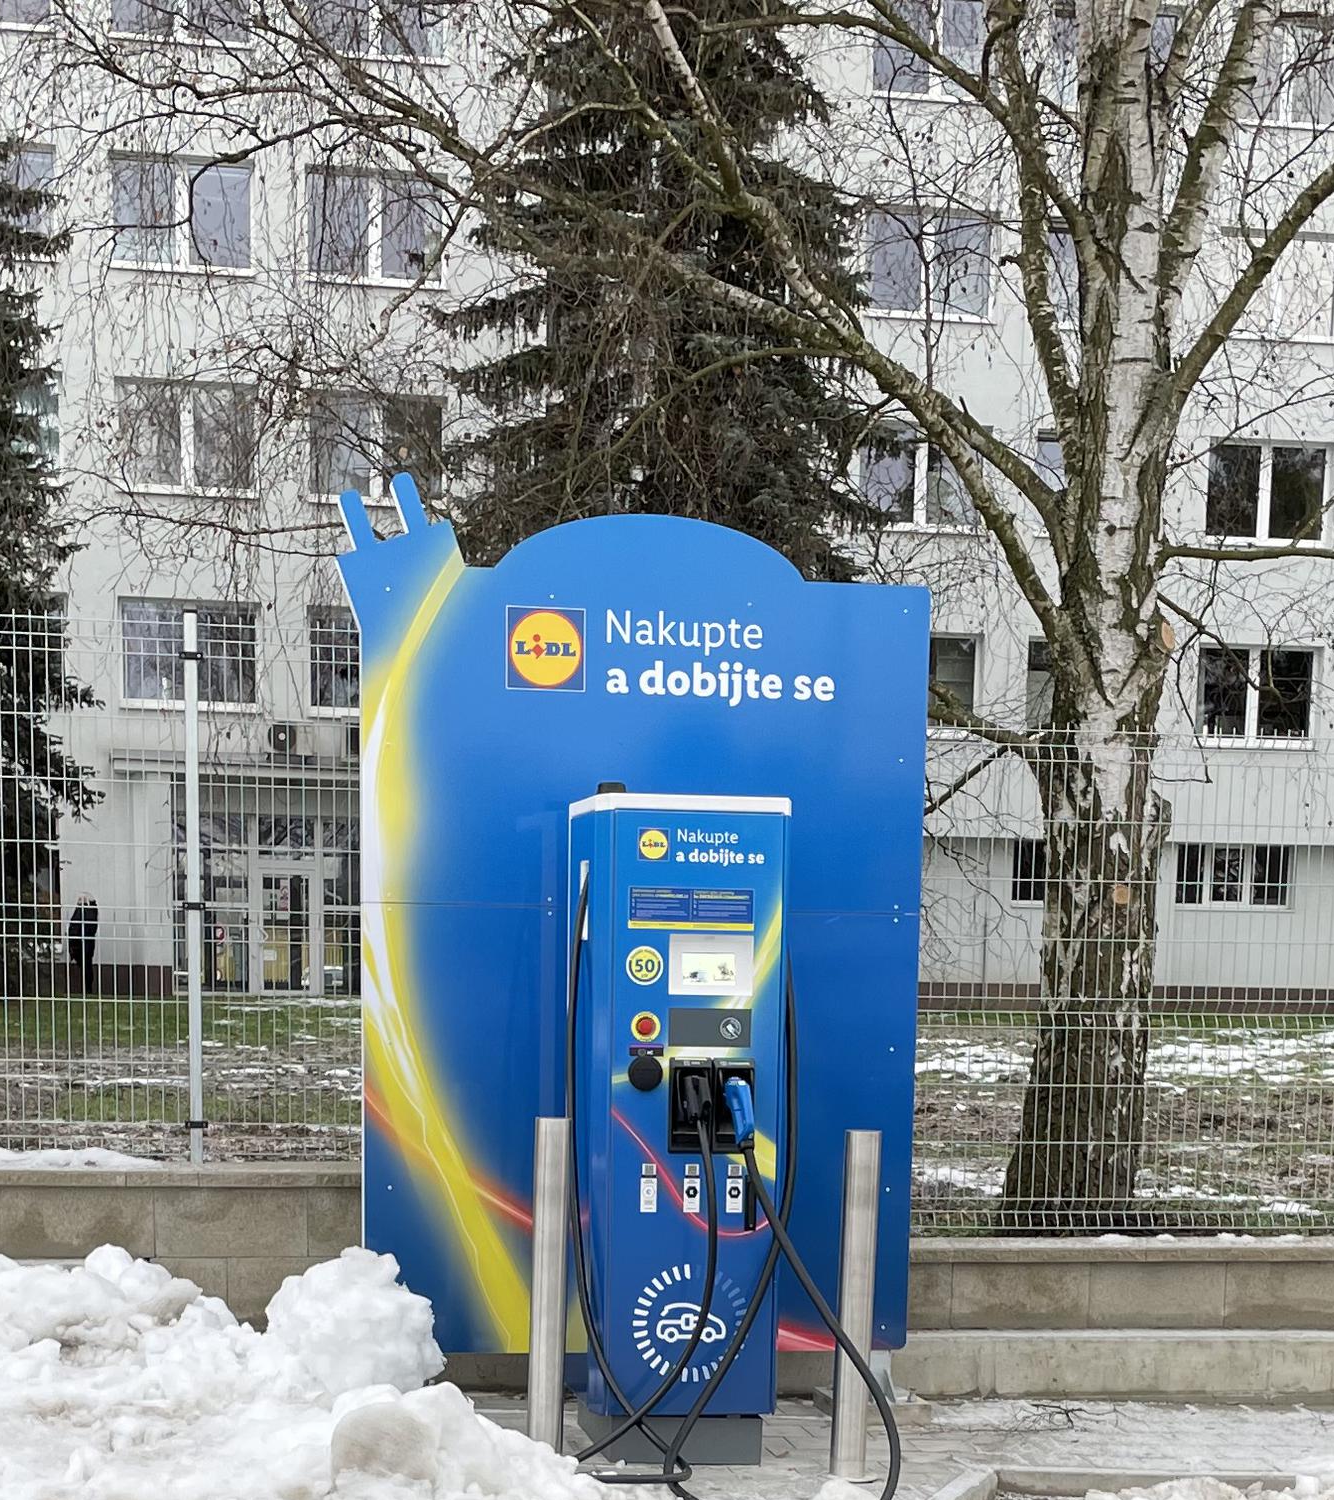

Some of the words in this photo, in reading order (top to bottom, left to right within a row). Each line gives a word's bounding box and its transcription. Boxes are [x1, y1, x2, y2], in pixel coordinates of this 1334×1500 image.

[605, 609, 764, 656] Nakupte
[605, 668, 629, 694] a
[639, 659, 783, 707] dobijte
[792, 675, 836, 702] se
[677, 828, 739, 847] Nakupte
[675, 852, 686, 863] a
[688, 847, 745, 867] dobijte
[747, 853, 765, 865] se
[635, 958, 655, 973] 50
